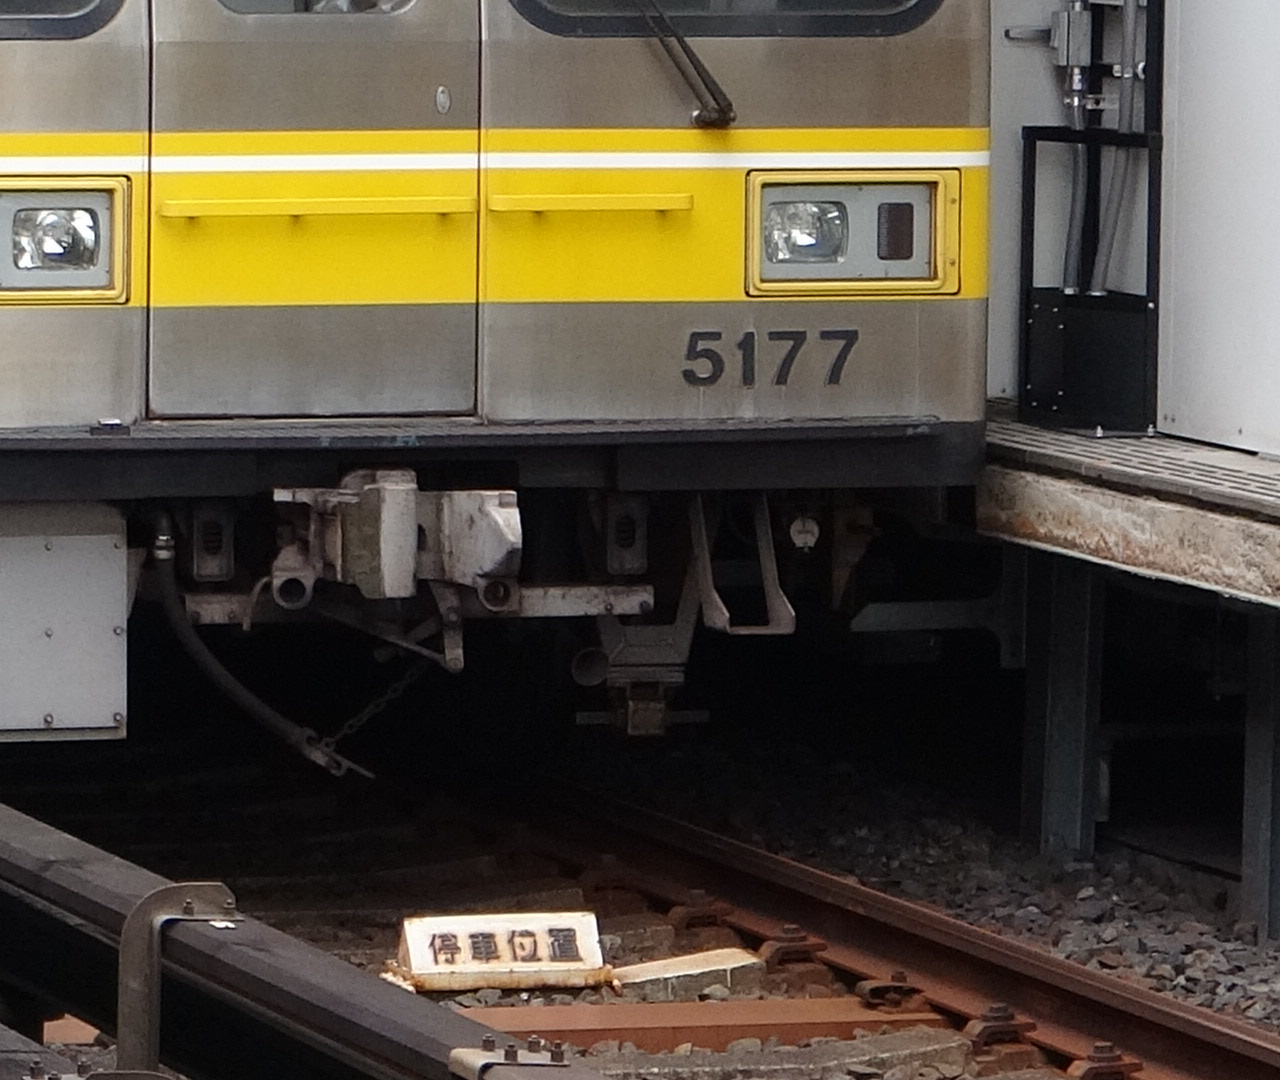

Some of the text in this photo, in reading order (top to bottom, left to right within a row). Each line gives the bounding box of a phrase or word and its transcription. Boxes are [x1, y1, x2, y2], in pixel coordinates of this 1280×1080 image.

[681, 329, 860, 387] 5177
[428, 927, 583, 965] 停車位置
